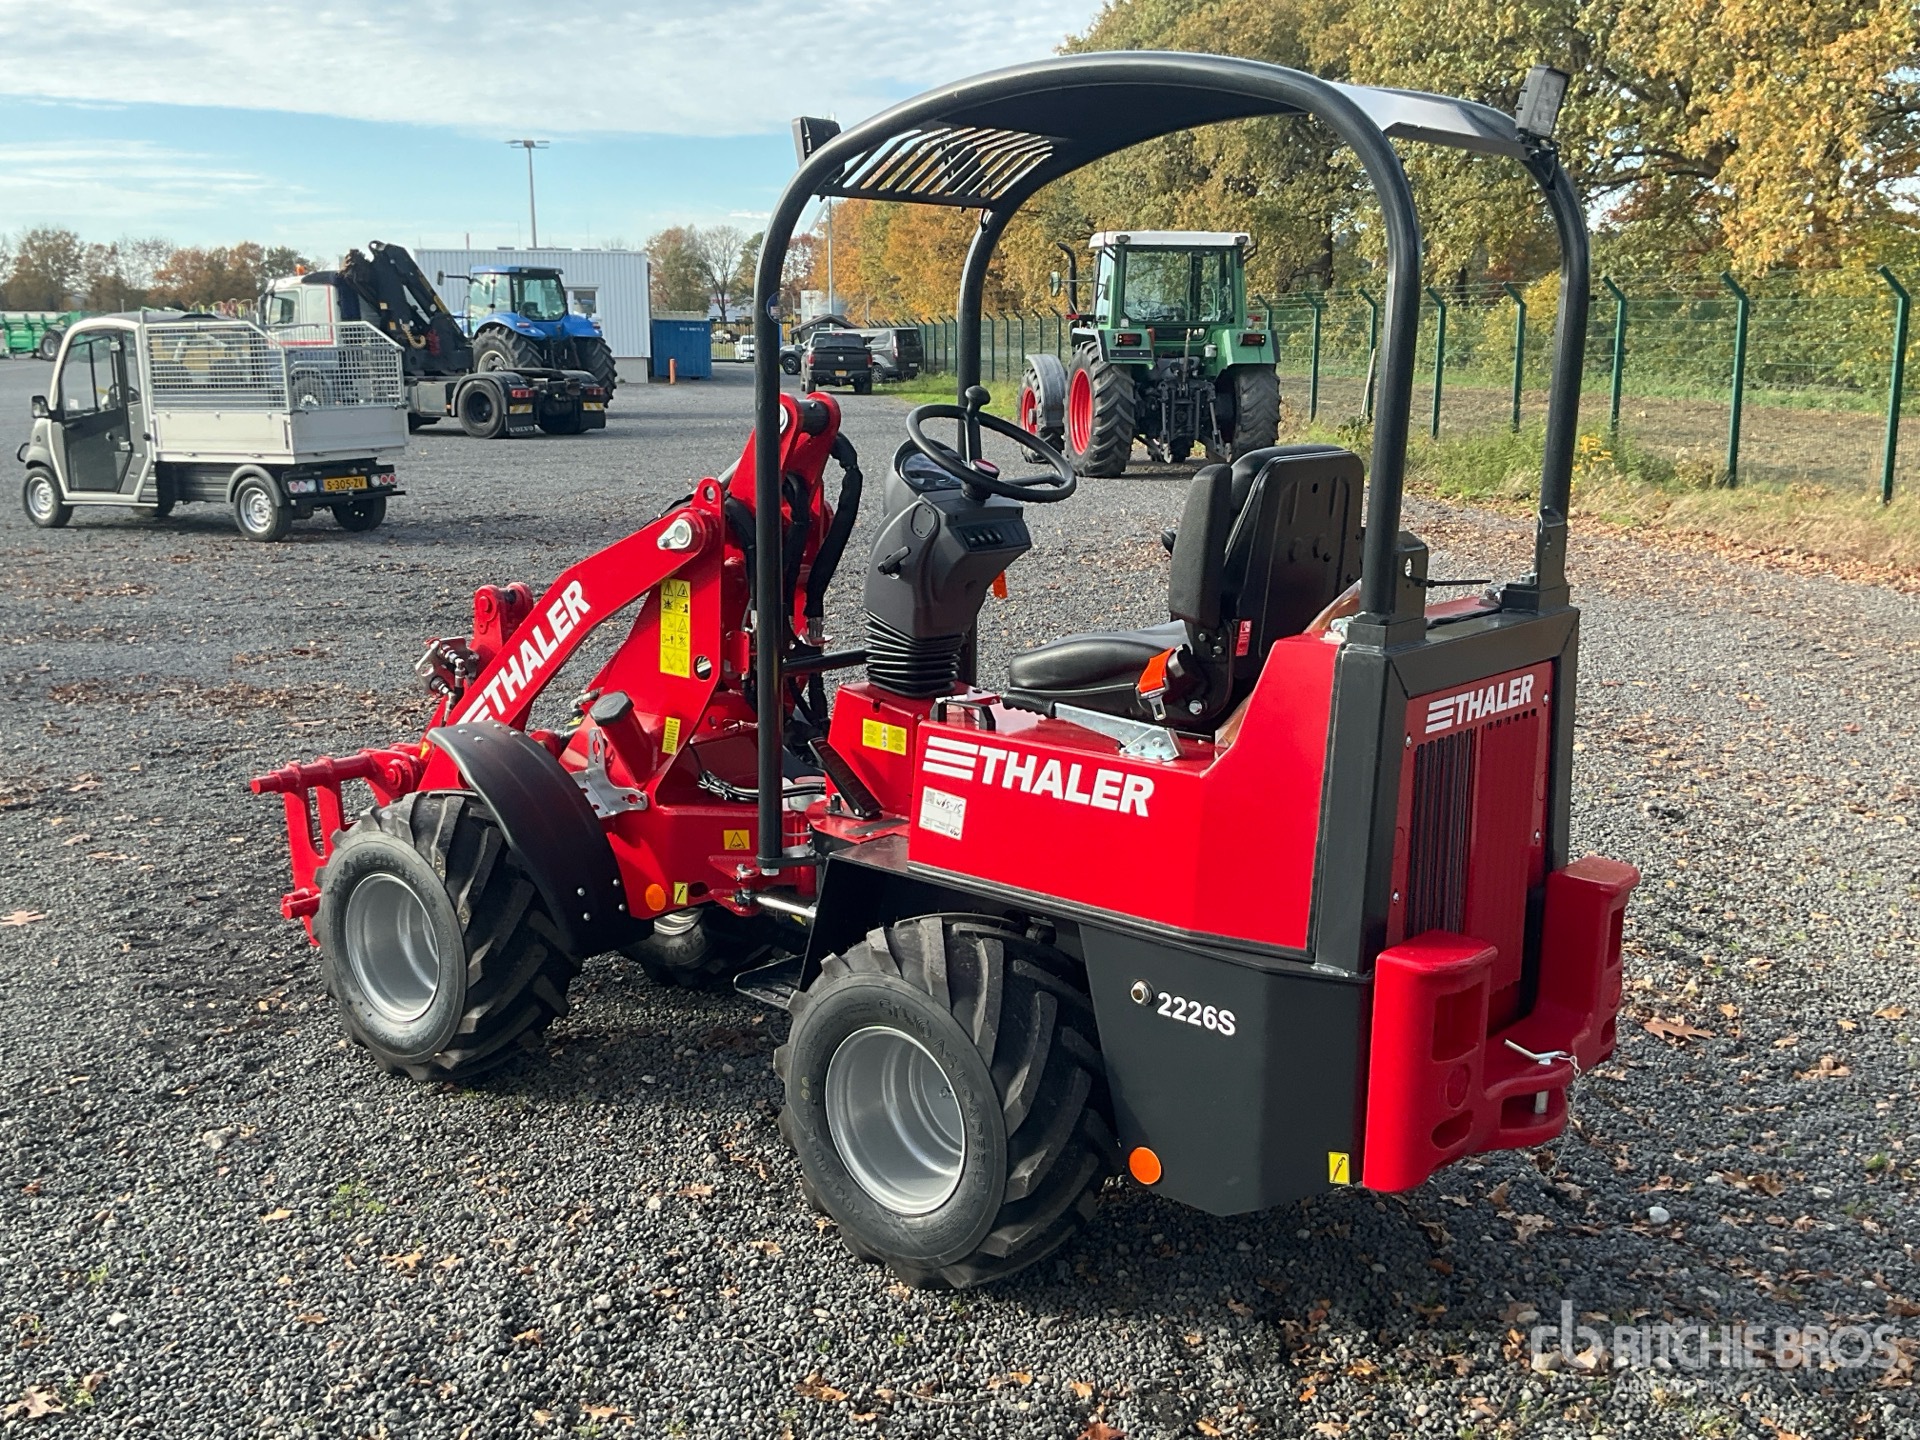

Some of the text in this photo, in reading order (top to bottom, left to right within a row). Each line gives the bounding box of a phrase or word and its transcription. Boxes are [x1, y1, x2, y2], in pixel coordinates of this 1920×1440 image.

[327, 478, 364, 490] S-305-ZV
[483, 580, 591, 715] THALER
[1454, 674, 1534, 725] THALER
[979, 745, 1155, 817] THALER
[1157, 991, 1236, 1036] 2226S
